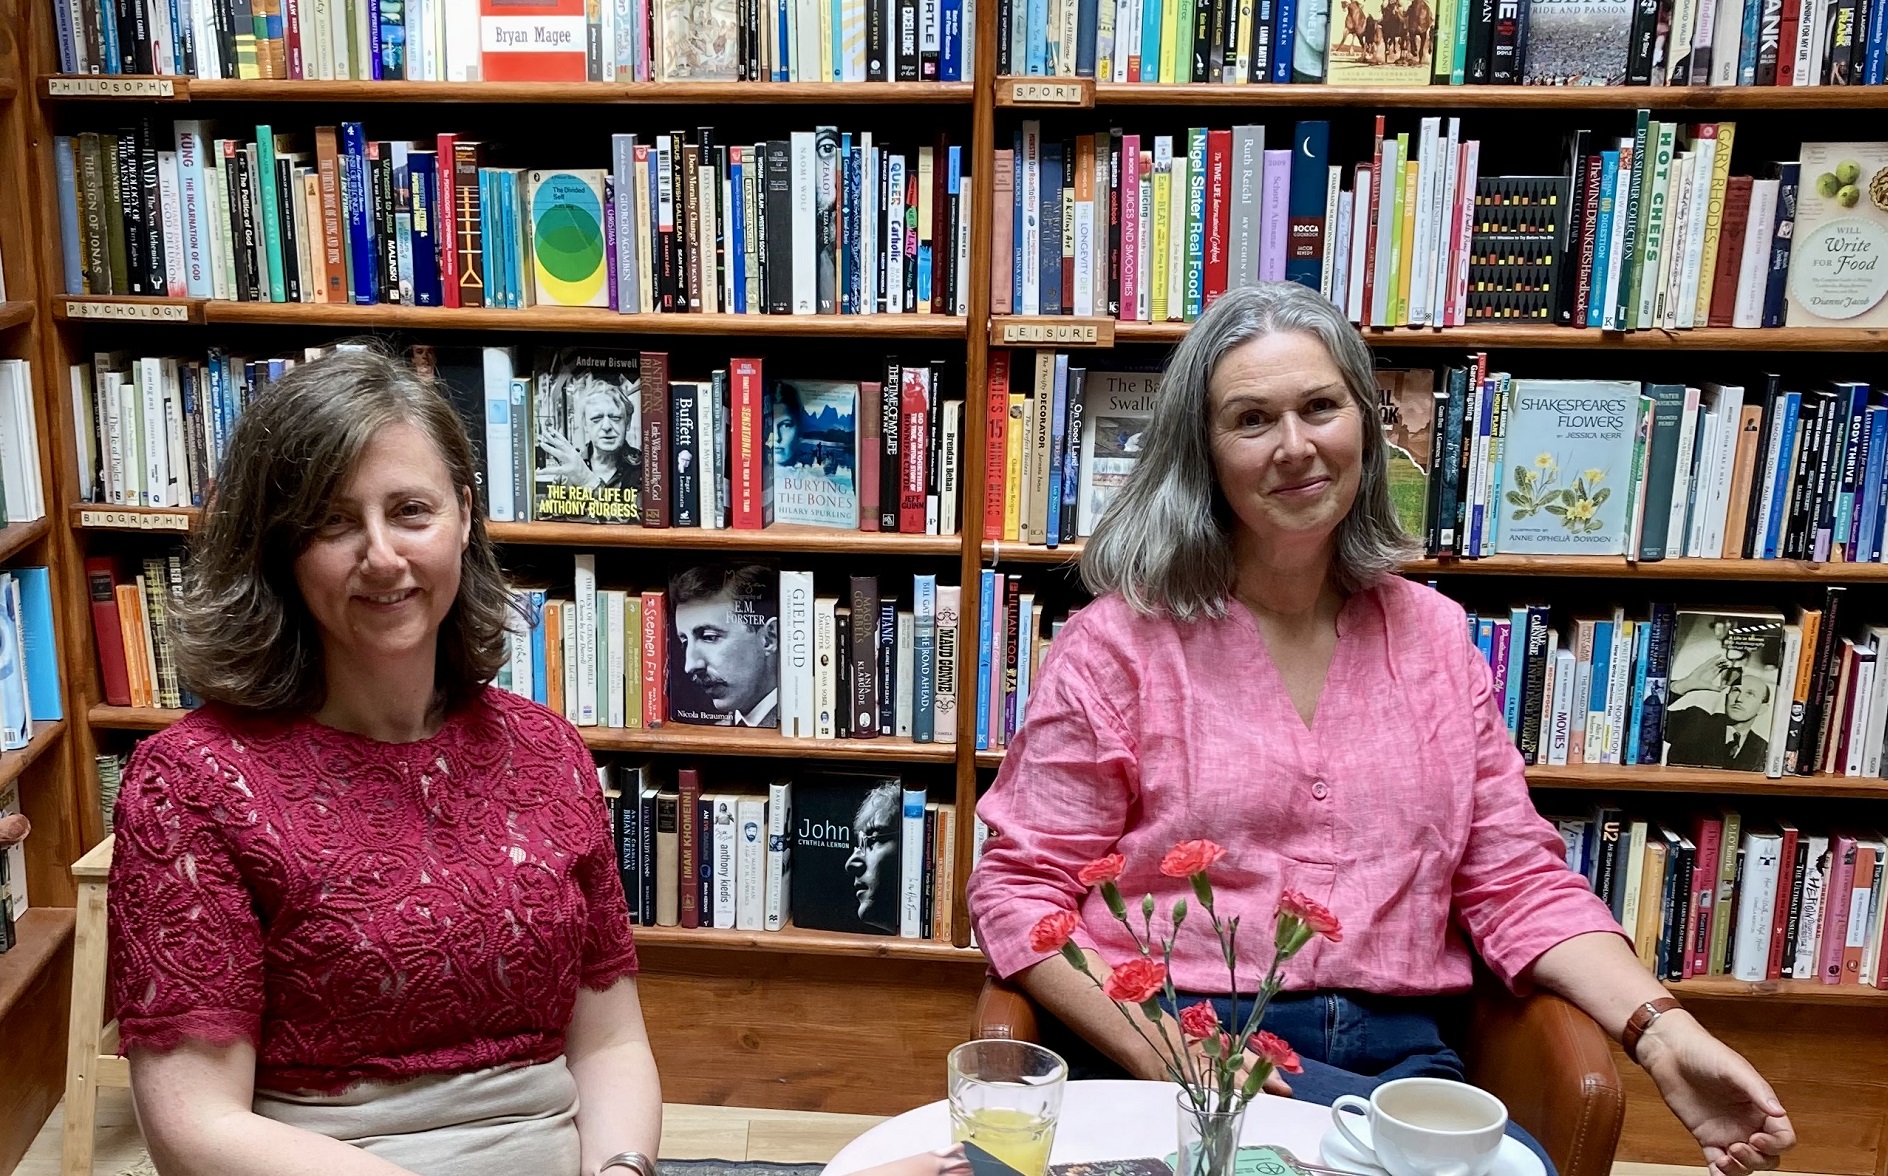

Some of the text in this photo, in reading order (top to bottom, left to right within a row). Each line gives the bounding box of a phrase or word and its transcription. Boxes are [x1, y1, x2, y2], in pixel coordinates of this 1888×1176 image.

[1281, 6, 1290, 45] PAULSEN
[1529, 6, 1626, 14] PRIDE AND PASSION
[1834, 8, 1849, 47] FRANK
[495, 26, 571, 46] Bryan Magee
[872, 27, 880, 50] BYRNE
[1257, 1, 1270, 68] MIND LIAM HAYES
[1799, 25, 1811, 61] FOR MY LIFE
[51, 81, 170, 93] PHILOSOPHY
[1016, 86, 1078, 98] SPORT
[180, 132, 195, 168] KÜNG
[823, 160, 831, 196] ZEALOT
[1129, 175, 1135, 183] OF
[1241, 139, 1254, 204] Ruth Reichl
[1704, 130, 1732, 243] GARY RHODES
[239, 171, 254, 246] The Politics of God
[688, 153, 700, 245] Does Morality Change?
[1125, 188, 1135, 219] JUICES
[1624, 128, 1647, 260] DELIA'S SUMMER COLLECTION
[1646, 132, 1672, 262] HOT CHEFS
[84, 155, 102, 274] THE SIGN OF JONAS
[185, 177, 201, 281] THE INCARNATION OF GOD
[1125, 221, 1134, 242] AND
[1188, 134, 1206, 298] Nigel Slater Real Food
[1293, 225, 1319, 233] BOCCA
[620, 193, 632, 281] GIORGIO AGAMBEN
[1080, 204, 1089, 296] THE LONGEVITY DIET
[1577, 161, 1602, 310] The WINE DRINKER'S Handbook
[1598, 213, 1609, 258] DIGESTION
[1825, 237, 1871, 252] Write
[387, 240, 398, 281] MALINSKI
[1124, 244, 1134, 296] SMOOTHIES
[1813, 255, 1878, 275] FOR Food
[68, 305, 184, 317] PSYCHOLOGY
[1810, 297, 1870, 308] Dianne Jacob
[1007, 327, 1094, 339] LEISURE
[576, 356, 637, 369] Andrew Biswell
[640, 358, 663, 414] ANTHONY BURGESS
[1464, 365, 1479, 421] Garden lighting
[679, 397, 693, 445] Buffett
[917, 413, 924, 424] GO
[1521, 398, 1626, 415] SHAKESPEARE'S
[1557, 416, 1624, 431] FLOWERS
[109, 414, 122, 482] The Te of Piglet
[1071, 404, 1083, 466] On Good Land
[1600, 432, 1622, 440] KERR
[1845, 416, 1862, 483] BODY THRIVE
[945, 432, 955, 492] Brendan Behan
[1757, 403, 1783, 536] QUIT SMOKING TODAY PAUL McKENNA
[547, 485, 638, 502] THE REAL LIFE OF
[778, 492, 853, 509] THE BONES
[784, 477, 848, 494] BURYING
[84, 513, 185, 526] BIOGRAPHY
[539, 500, 638, 517] ANTHONY BURGESS
[778, 506, 852, 519] HILARY SPURLING
[726, 612, 765, 626] FORSTER
[734, 601, 755, 613] E.M.
[854, 590, 872, 643] MAGDA GOEBBELS
[882, 606, 893, 644] TITANIC
[644, 608, 657, 682] Stephen Fry
[792, 588, 805, 668] GIELGUD
[1007, 594, 1018, 663] LILLIAN TOO
[1528, 615, 1548, 655] DALE CARNEGIE
[920, 628, 930, 707] THE ROAD AHEAD
[937, 629, 954, 692] MAUD GONNE
[857, 661, 866, 705] KLABUNDE
[864, 672, 872, 693] ANJA
[677, 709, 733, 721] Nicola Beauman
[1554, 712, 1568, 749] MOVIES
[623, 809, 631, 870] BRIAN KEENAN
[681, 791, 692, 879] IMAM KHOMEINI
[798, 840, 850, 849] CYNTHIA LENNON
[799, 818, 849, 841] John
[1603, 821, 1620, 842] U2
[719, 844, 732, 903] anthony kiedis
[1786, 864, 1805, 941] THE ULTIMATE INSULT
